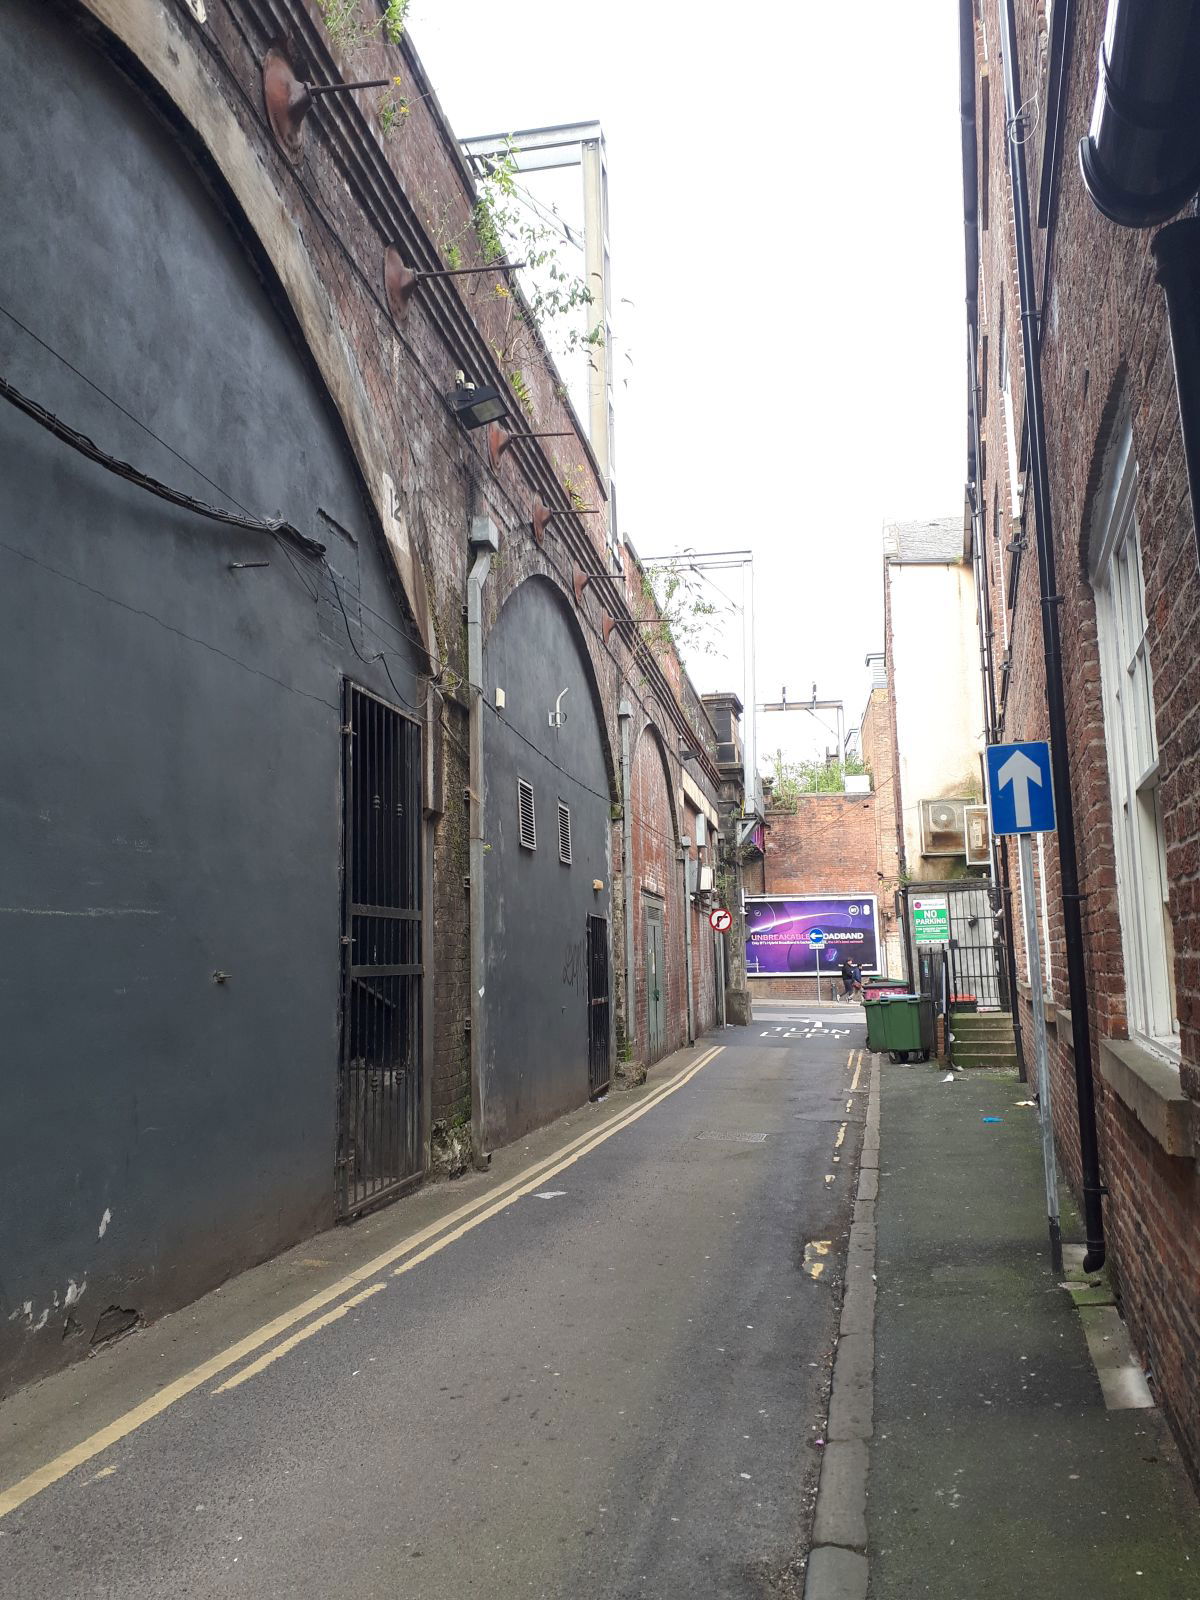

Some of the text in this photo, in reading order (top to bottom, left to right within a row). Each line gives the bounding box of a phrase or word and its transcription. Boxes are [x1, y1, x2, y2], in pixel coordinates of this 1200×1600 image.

[924, 910, 937, 918] NO
[751, 932, 864, 941] UNBREAKABLE OADBAND
[771, 1026, 850, 1034] TURN
[760, 1031, 848, 1039] LEFT
